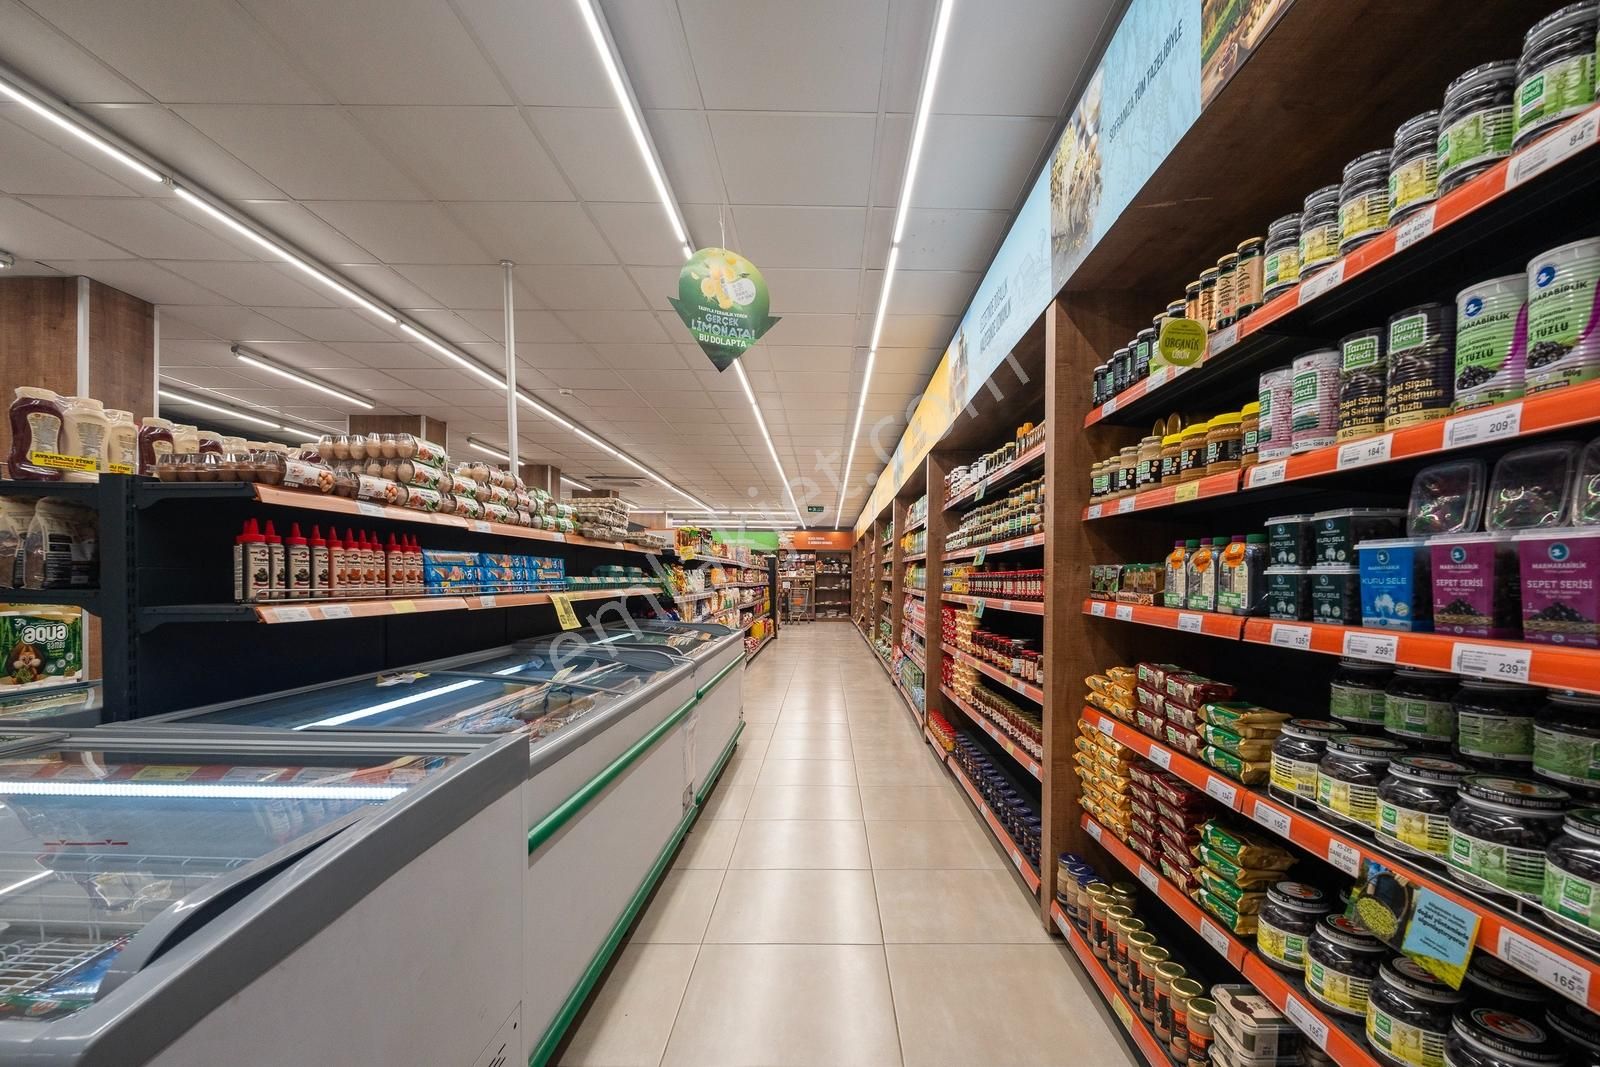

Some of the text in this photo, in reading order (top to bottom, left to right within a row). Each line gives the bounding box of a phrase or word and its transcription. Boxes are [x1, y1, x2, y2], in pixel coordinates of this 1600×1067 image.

[1134, 77, 1147, 105] TÜM
[1569, 130, 1585, 146] 84
[705, 313, 739, 327] GERÇEK
[691, 317, 756, 340] LİMONATA!
[1394, 320, 1421, 334] Tarım
[1536, 321, 1569, 339] TUZLU
[699, 333, 747, 348] BU DOLAPTA
[1165, 335, 1200, 350] ORGANİK
[1393, 329, 1420, 345] Kredi
[1346, 342, 1374, 353] Tarım
[1347, 351, 1371, 362] Kredi
[1465, 349, 1494, 362] TUZLU
[1405, 379, 1433, 390] Siyah
[1358, 396, 1383, 404] Siyah
[1397, 389, 1443, 402] Salamura
[1399, 402, 1423, 412] Tuzlu
[1352, 415, 1374, 425] Tuzlu
[1489, 421, 1509, 432] 209
[1436, 578, 1484, 587] SEPET SERİSİ
[1527, 579, 1593, 589] SEPET SERİSİ
[22, 624, 67, 643] aqua
[1375, 646, 1389, 655] 299
[1499, 663, 1519, 674] 239
[1553, 972, 1575, 991] 165
